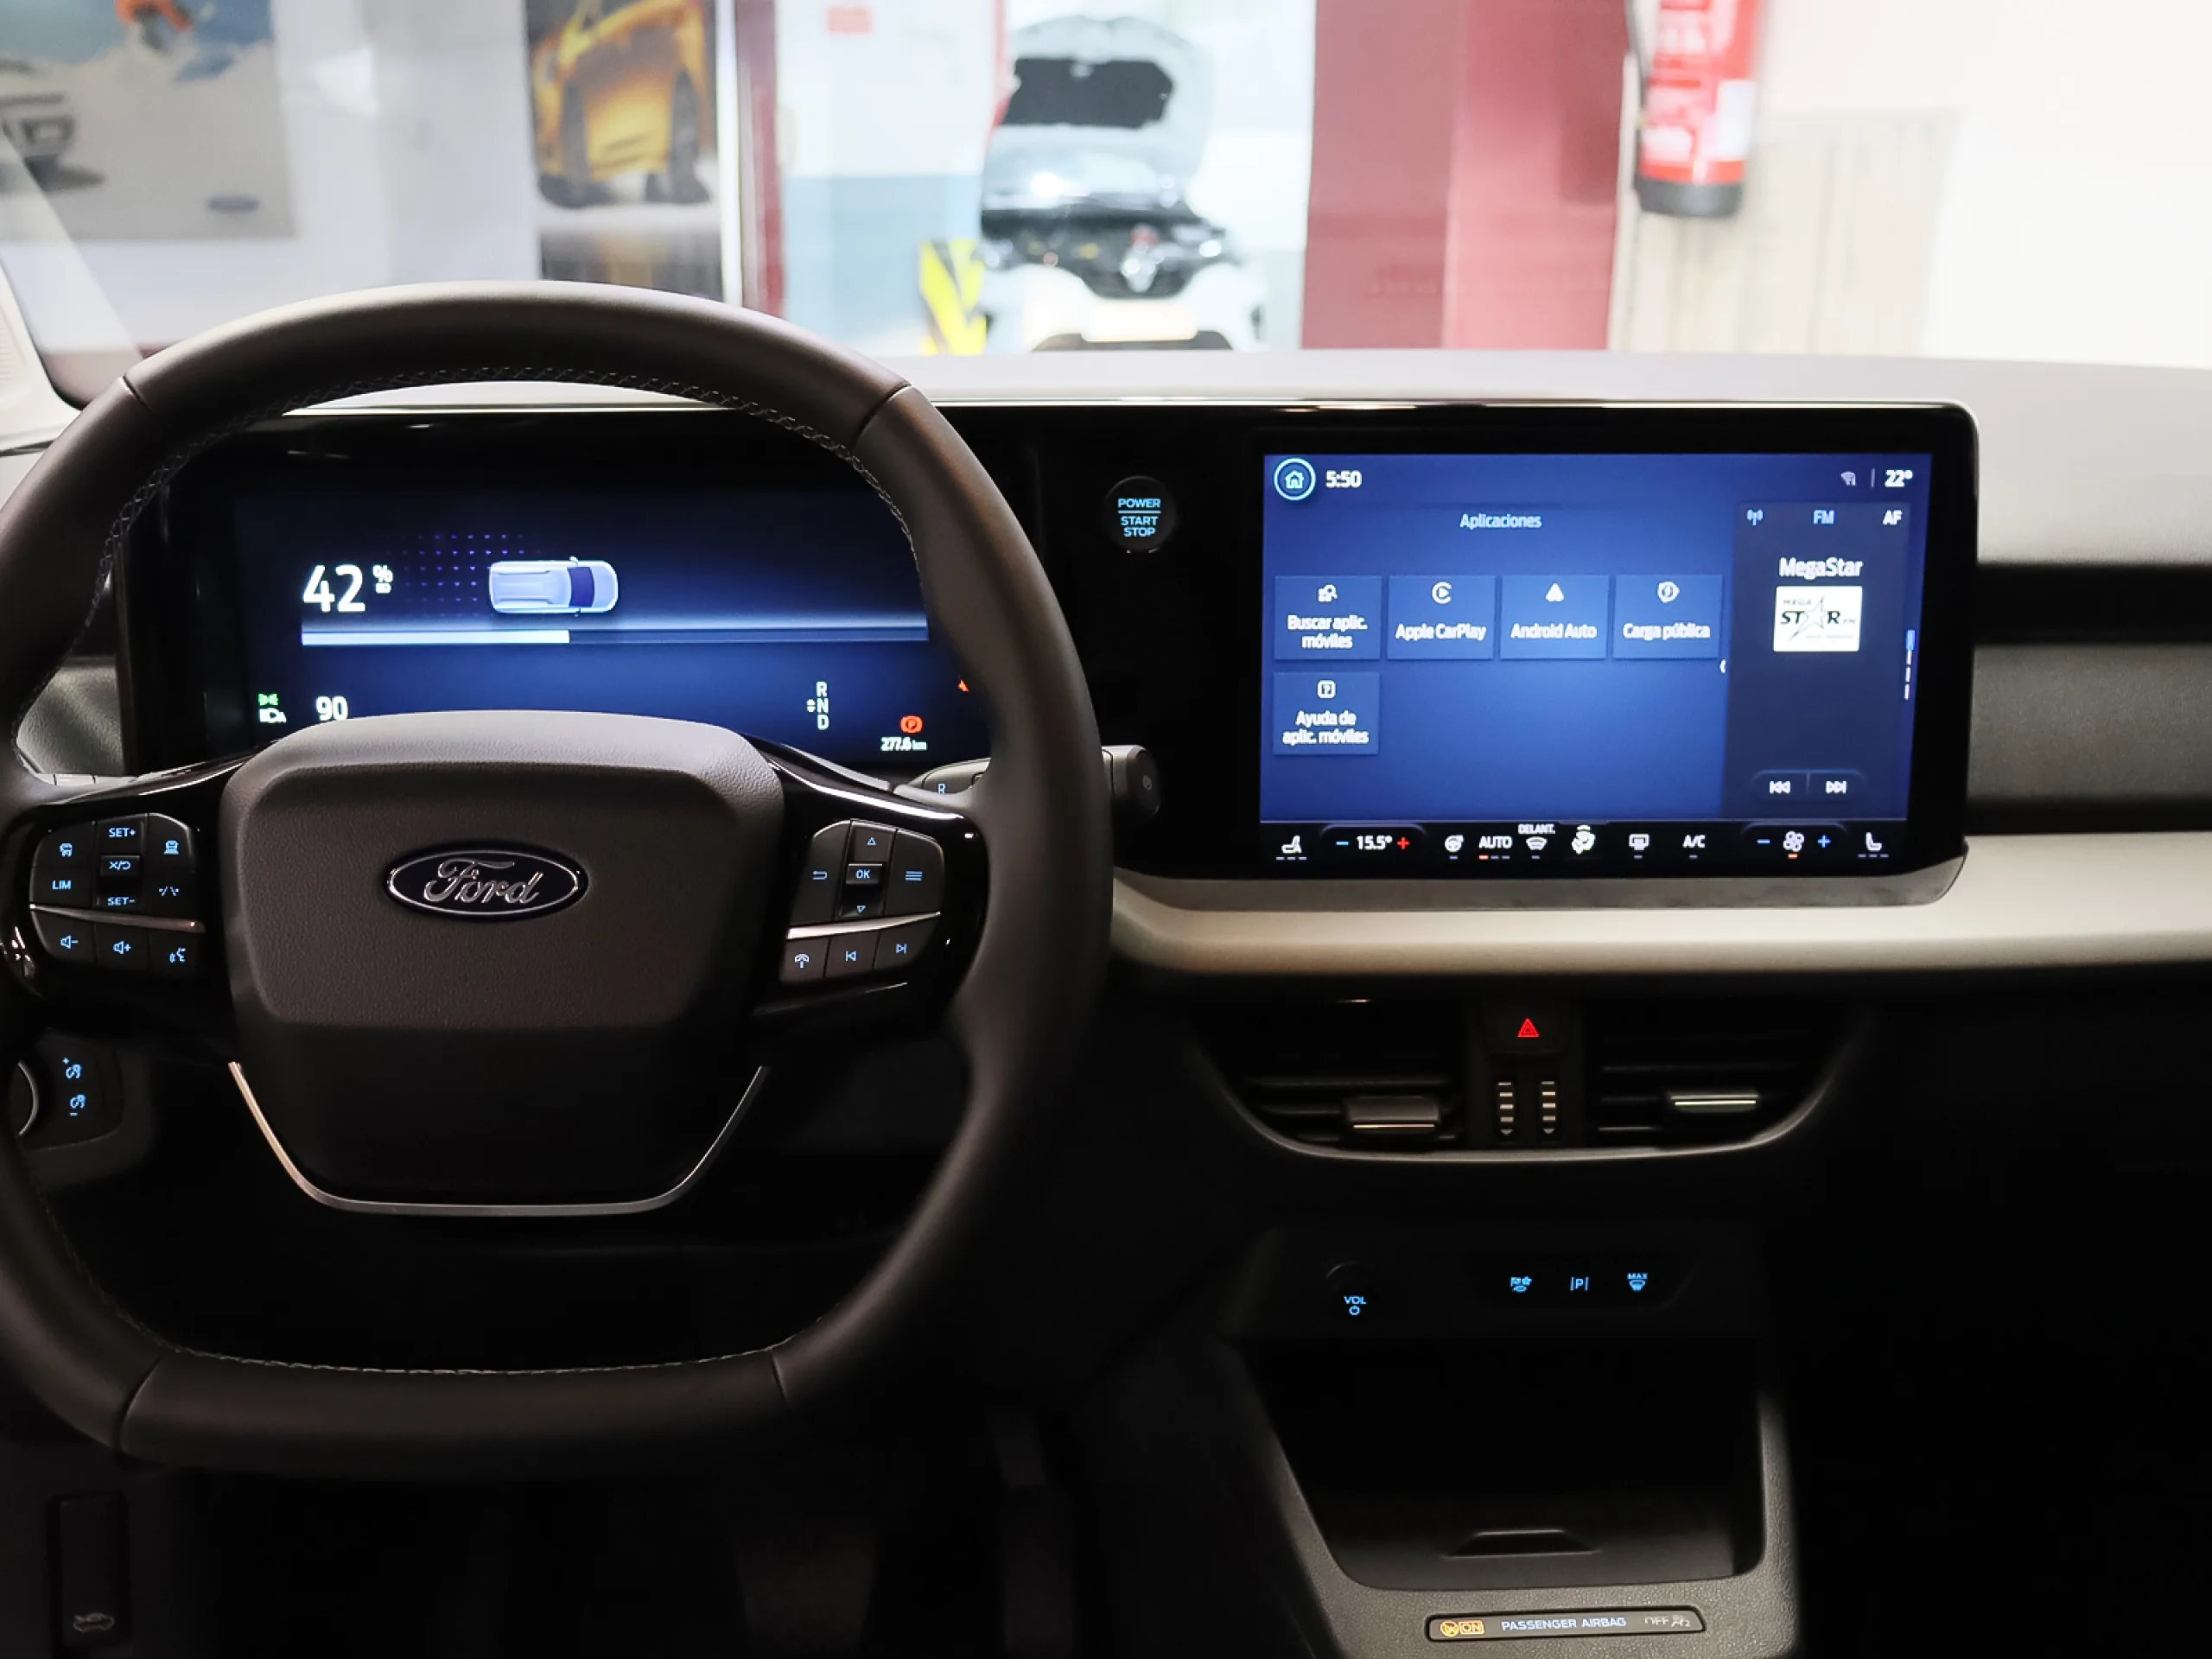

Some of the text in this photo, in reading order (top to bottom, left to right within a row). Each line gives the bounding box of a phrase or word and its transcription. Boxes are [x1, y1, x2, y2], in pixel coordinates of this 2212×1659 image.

[1325, 470, 1363, 489] 5:50
[1117, 497, 1161, 508] POWER
[1120, 515, 1159, 526] START
[1459, 513, 1543, 530] Aplicaciones
[1813, 510, 1835, 525] FM
[1882, 510, 1904, 525] AF
[1123, 526, 1156, 537] STOP
[1778, 556, 1864, 581] MegaStar
[302, 563, 394, 613] 42 %
[1287, 614, 1369, 632] Buscar aplic.
[1510, 623, 1598, 639] Android Auto
[1623, 621, 1711, 641] Carga pública
[1395, 623, 1487, 641] Apple CarPlay
[1301, 633, 1353, 649] móviles
[816, 681, 828, 697] R
[315, 695, 348, 721] 90
[817, 697, 830, 713] N
[817, 715, 830, 730] D
[1295, 711, 1357, 728] Ayuda de
[1282, 728, 1370, 746] aplic. móviles
[912, 741, 927, 750] km
[1517, 823, 1555, 835] DELANT.
[1478, 836, 1512, 849] AUTO
[1682, 834, 1706, 849] A/C
[423, 857, 544, 905] Ford
[855, 868, 871, 880] OK
[53, 880, 71, 889] LIM
[1343, 1295, 1367, 1305] VOL
[1462, 1624, 1482, 1633] ON
[1501, 1620, 1577, 1631] PASSENGER
[1581, 1617, 1627, 1629] AIRBAG
